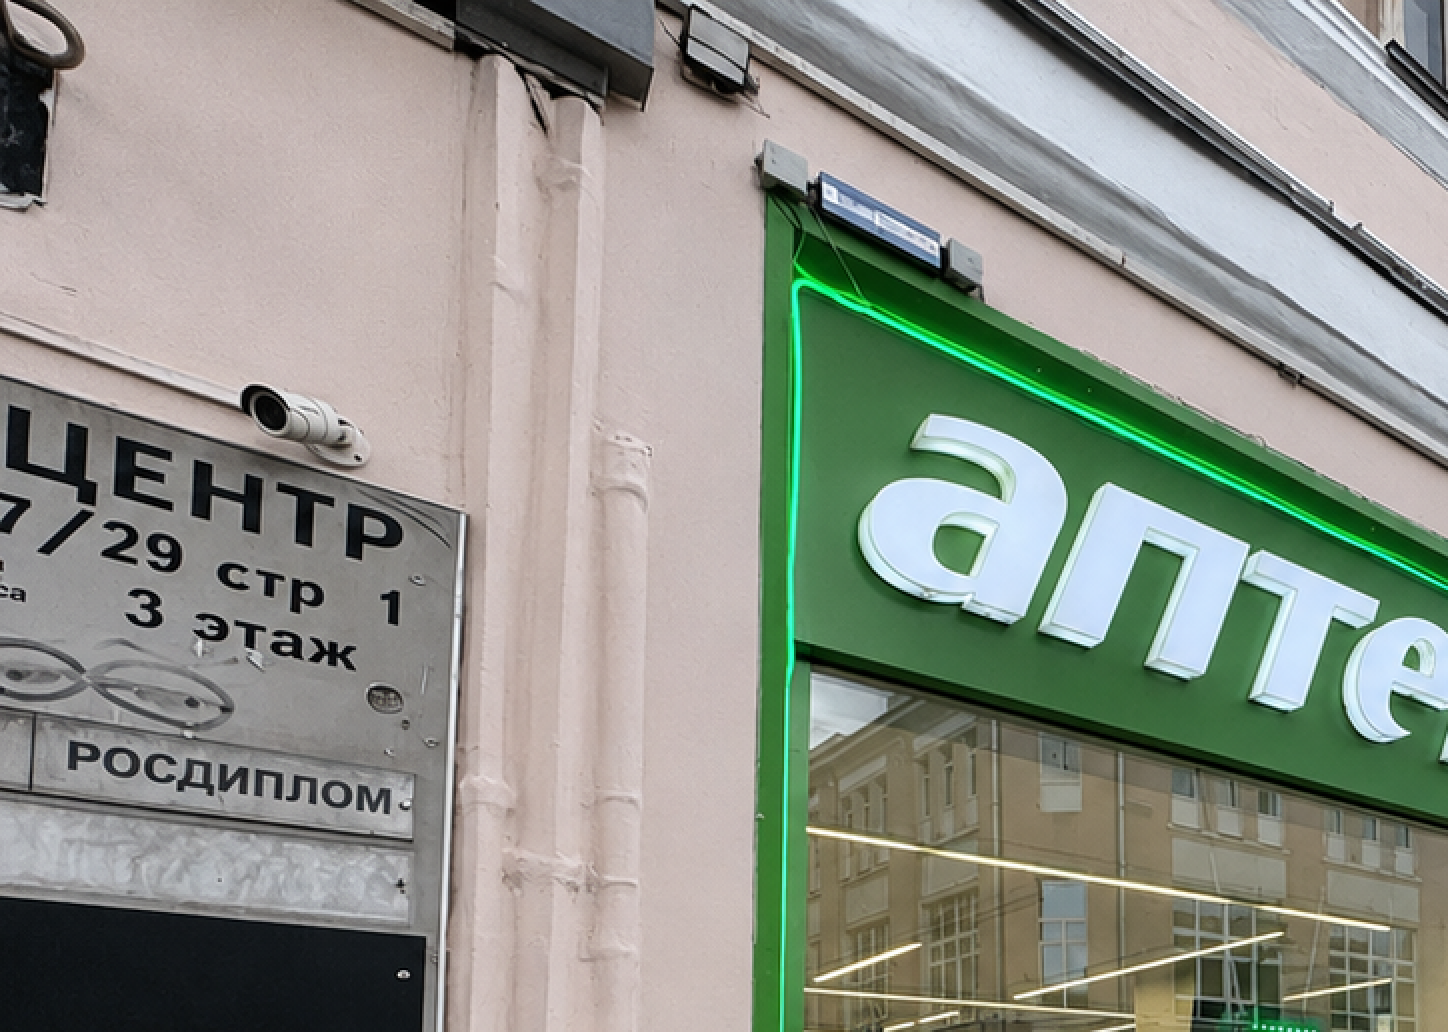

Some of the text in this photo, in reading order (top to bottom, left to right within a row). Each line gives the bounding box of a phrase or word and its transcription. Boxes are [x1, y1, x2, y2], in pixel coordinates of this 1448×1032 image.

[6, 405, 403, 560] ЦЕНТР
[125, 588, 358, 671] 3 этаж
[217, 562, 325, 613] стр
[380, 590, 401, 626] 1
[67, 740, 391, 815] РОСДИПЛОМ
